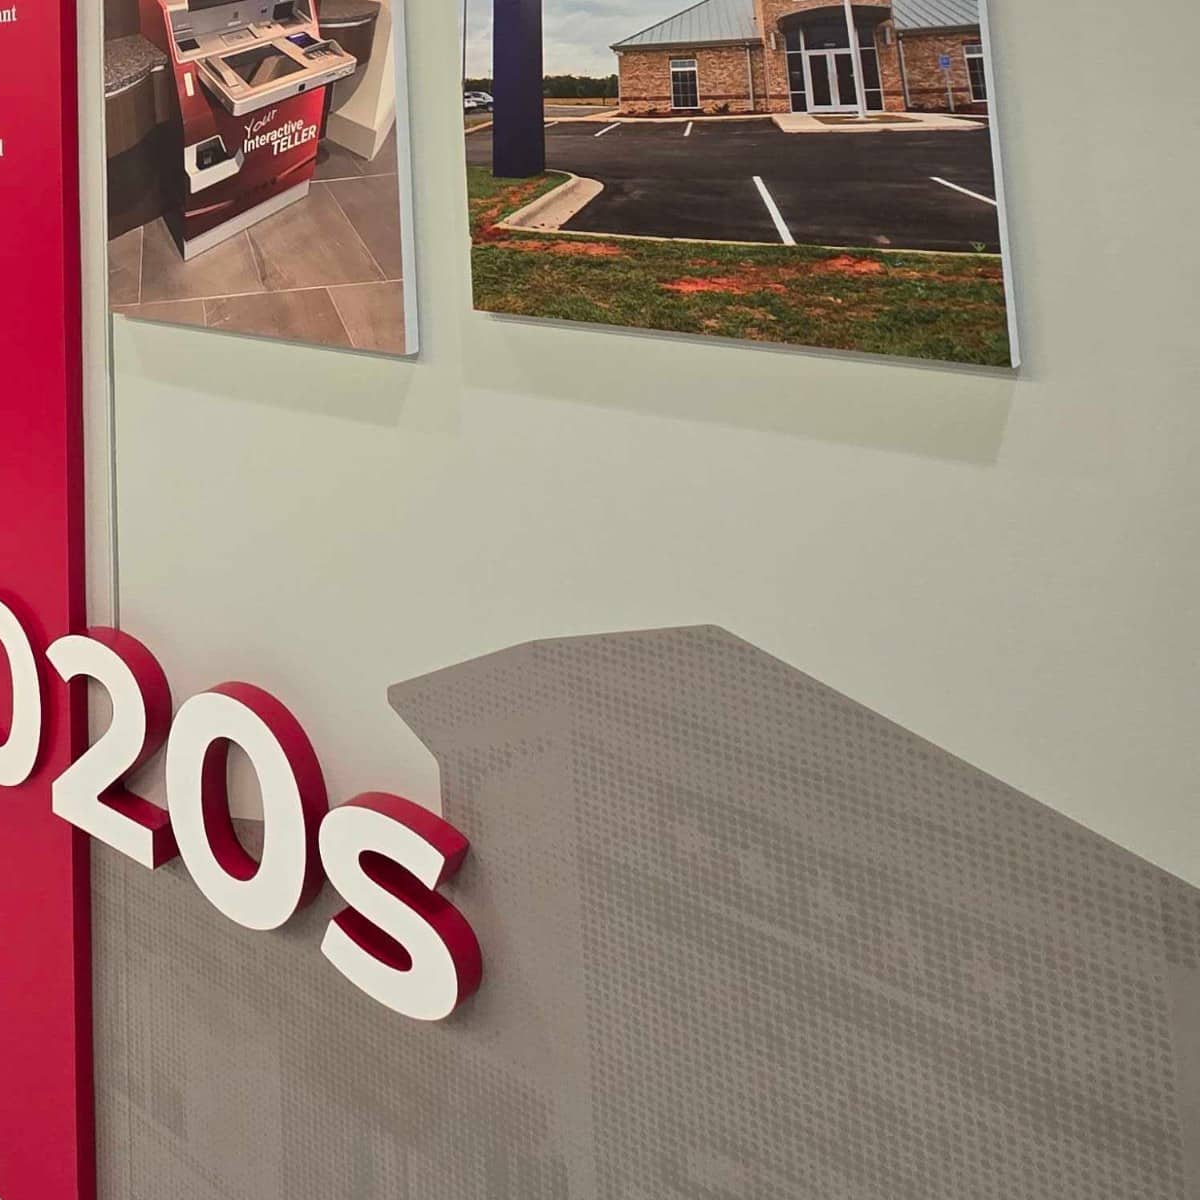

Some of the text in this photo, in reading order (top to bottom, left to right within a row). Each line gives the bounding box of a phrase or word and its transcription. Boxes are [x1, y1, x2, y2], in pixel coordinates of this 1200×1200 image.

[244, 109, 278, 139] Your
[244, 119, 304, 153] Interactive
[272, 125, 317, 156] TELLER
